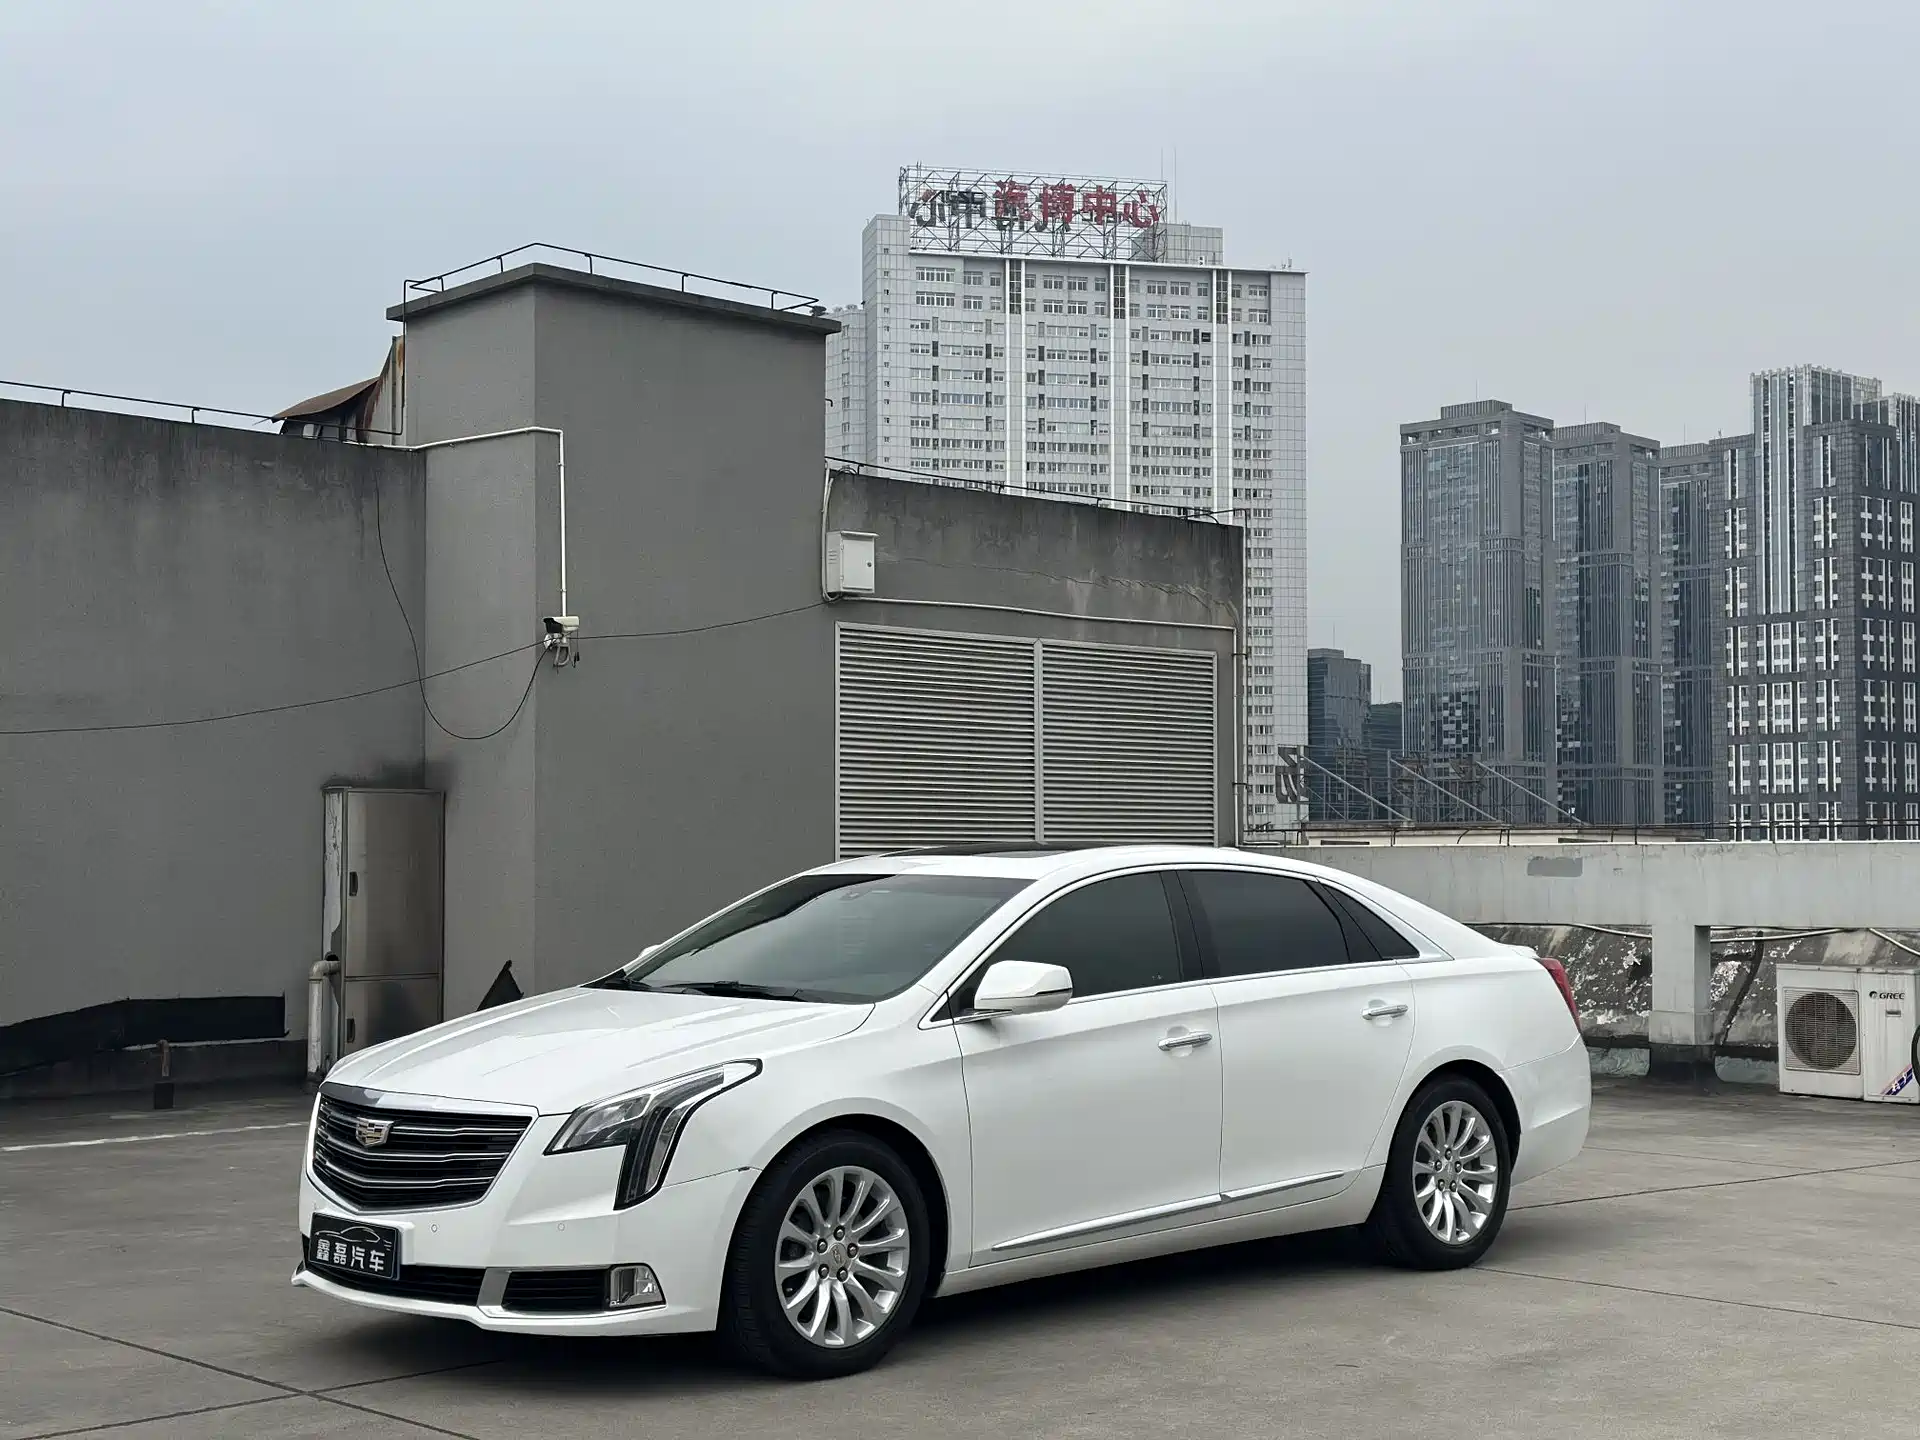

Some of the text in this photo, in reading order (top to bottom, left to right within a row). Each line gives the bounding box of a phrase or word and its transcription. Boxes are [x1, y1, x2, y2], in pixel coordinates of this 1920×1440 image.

[1879, 991, 1905, 1000] GREE
[316, 1238, 386, 1272] 鑫磊汽车
